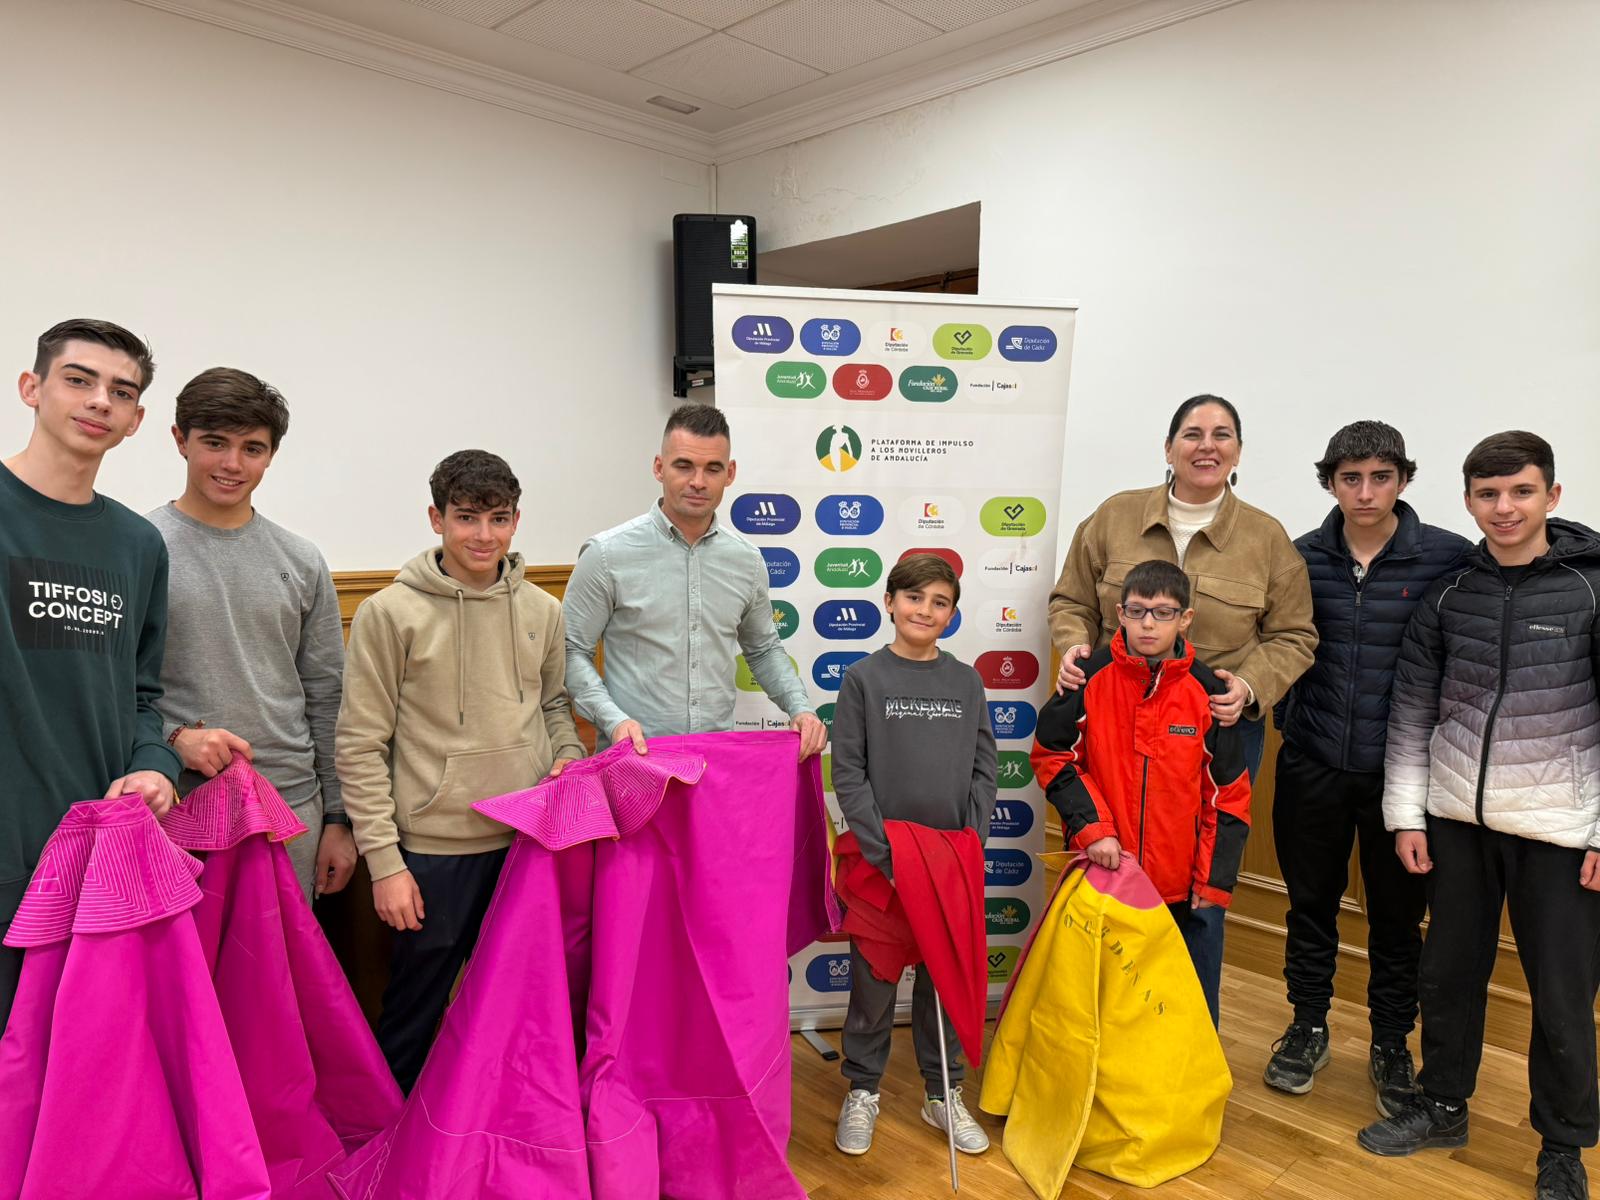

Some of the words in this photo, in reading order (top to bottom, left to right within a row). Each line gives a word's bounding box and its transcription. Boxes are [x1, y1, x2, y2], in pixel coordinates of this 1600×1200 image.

[1024, 337, 1050, 345] Diputación
[884, 454, 928, 462] ANDALUCÍA
[29, 581, 107, 607] TIFFOSI
[28, 601, 123, 629] CONCEPT
[885, 696, 962, 713] MCKENZIE
